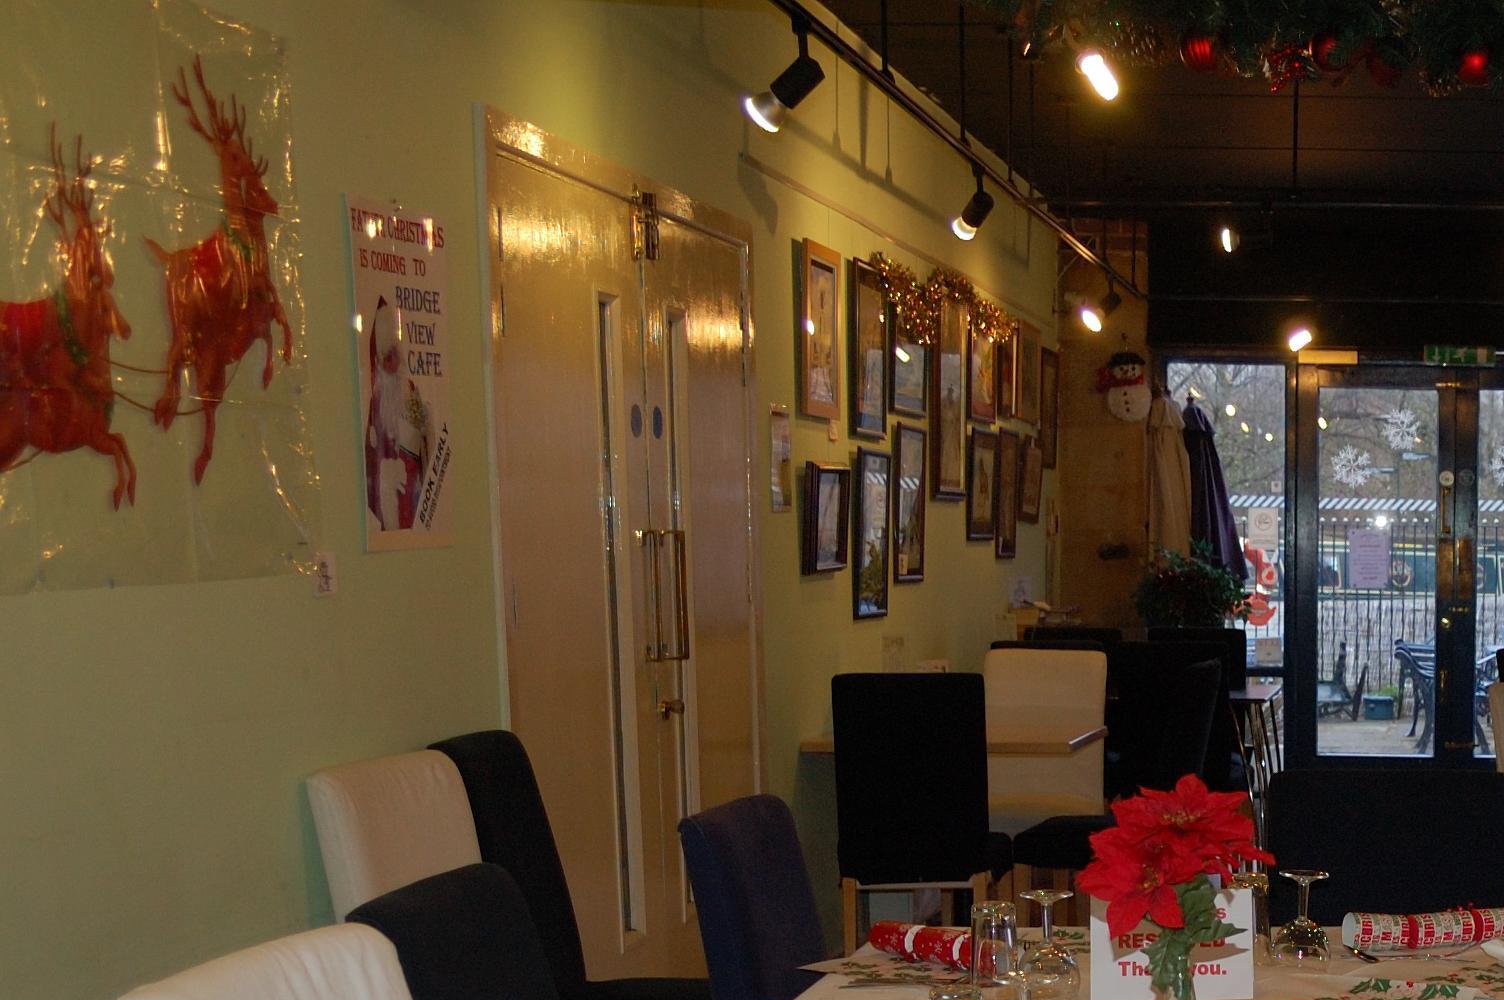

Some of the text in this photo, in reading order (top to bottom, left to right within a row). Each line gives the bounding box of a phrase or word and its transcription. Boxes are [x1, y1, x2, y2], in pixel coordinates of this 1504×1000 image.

[350, 207, 386, 238] FATER
[359, 247, 427, 278] IS COMING TO
[395, 286, 441, 315] BRIDGE
[405, 321, 436, 346] VIEW
[407, 352, 442, 378] CAFE
[419, 423, 449, 523] BOOK EARLY
[1118, 933, 1226, 949] RESED
